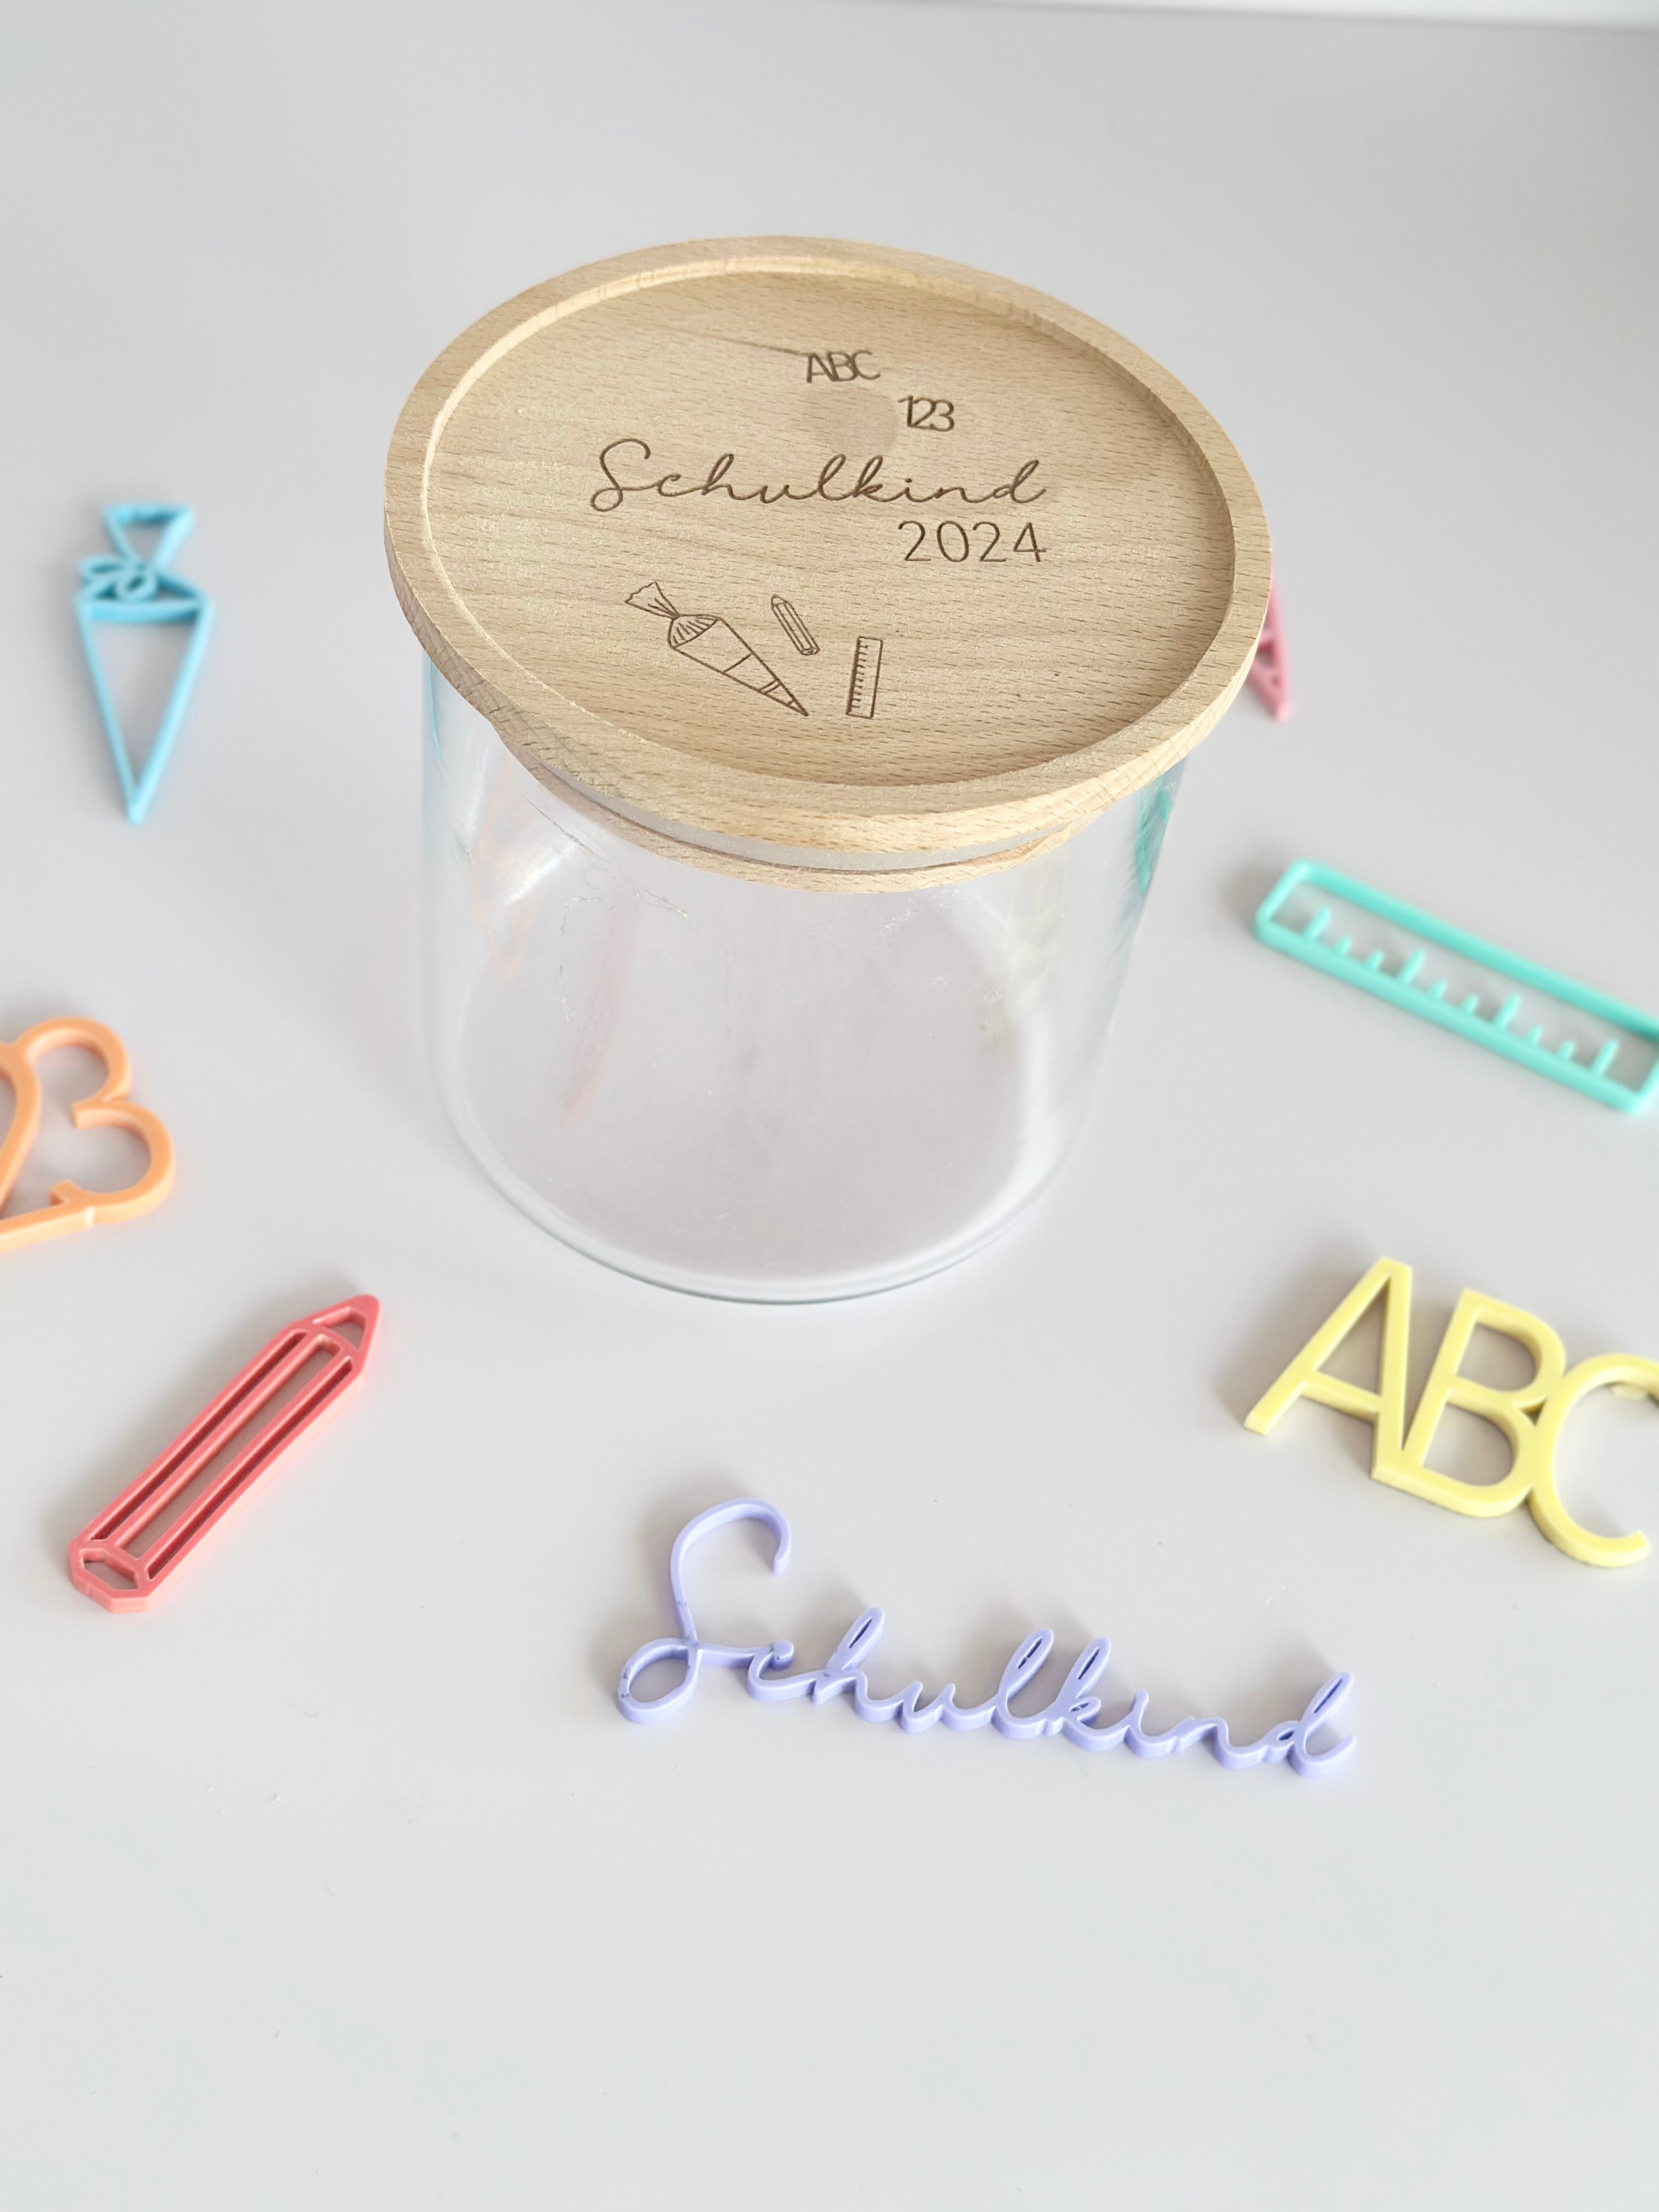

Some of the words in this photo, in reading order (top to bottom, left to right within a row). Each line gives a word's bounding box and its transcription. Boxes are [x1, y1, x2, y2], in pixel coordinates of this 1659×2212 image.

[806, 350, 881, 382] ABC
[898, 396, 955, 431] 123
[590, 438, 1047, 511] Schulkind
[898, 521, 1047, 562] 2024
[1244, 1256, 1659, 1567] ABC
[617, 1498, 1356, 1776] Schulkind
